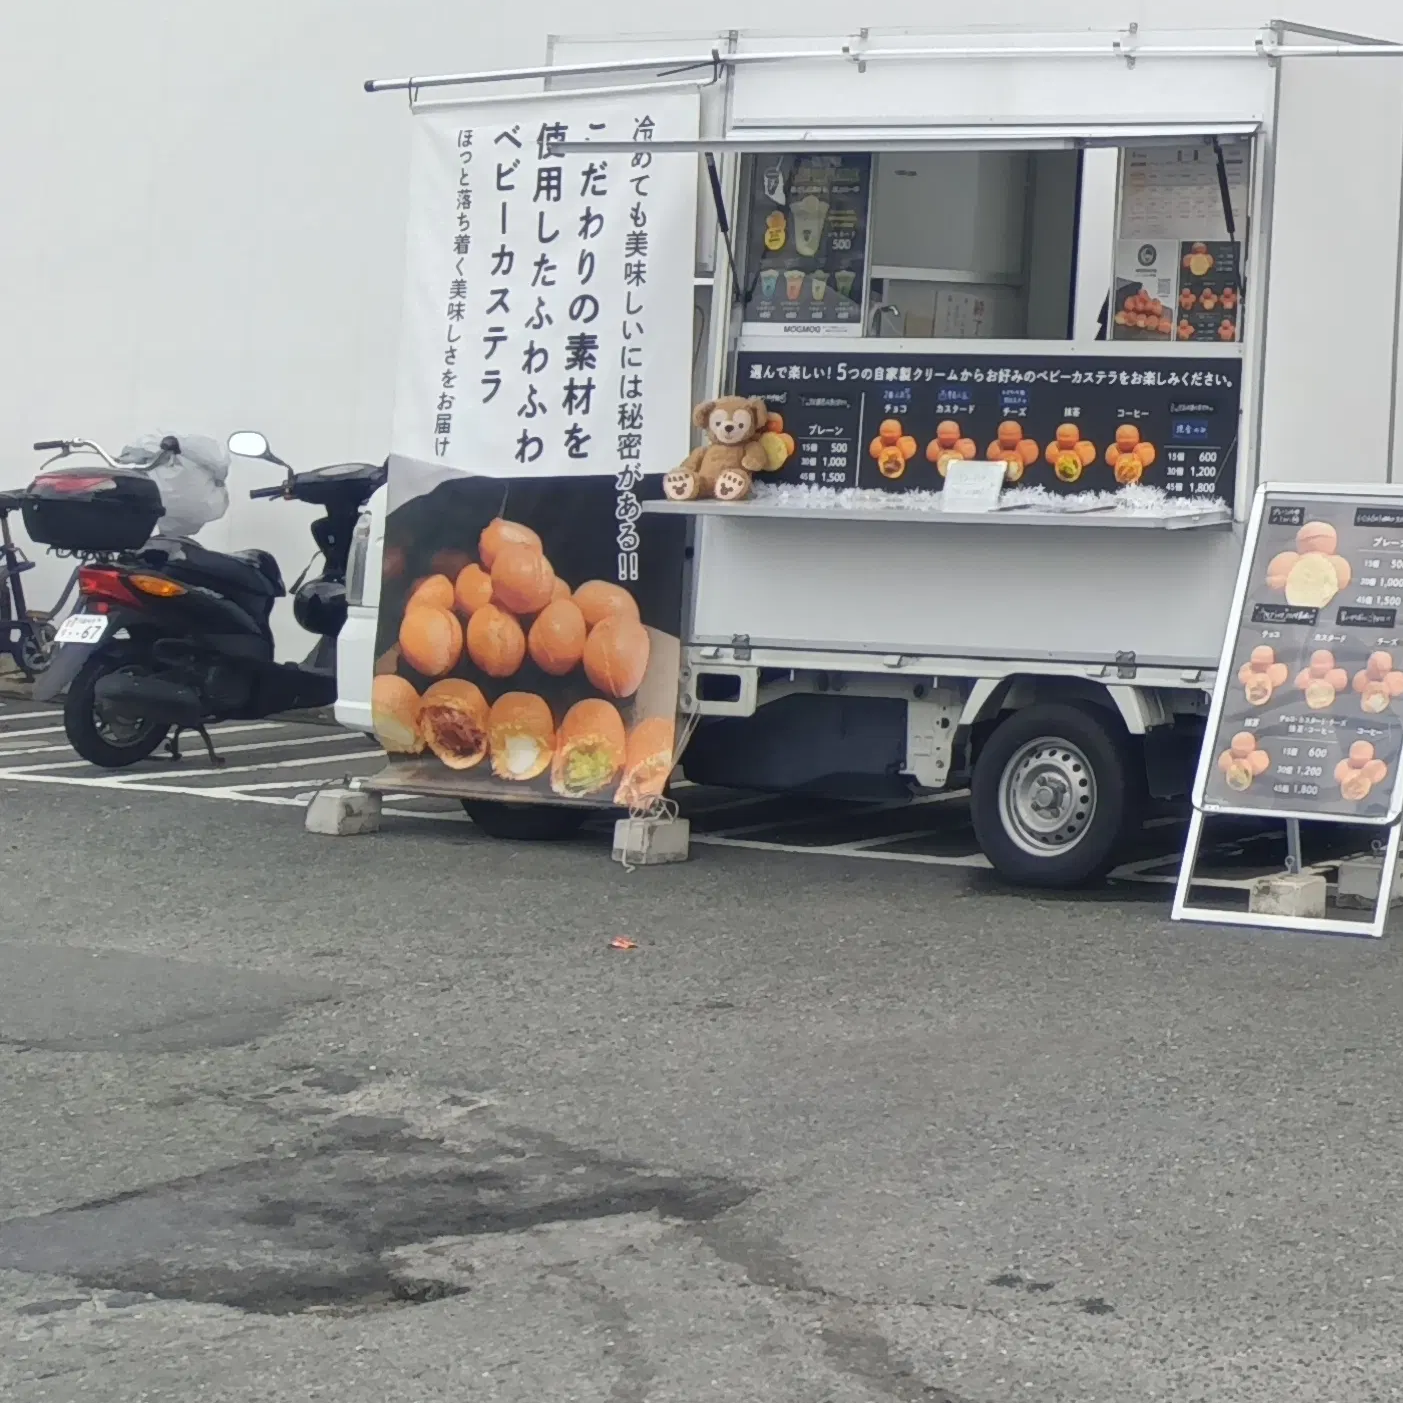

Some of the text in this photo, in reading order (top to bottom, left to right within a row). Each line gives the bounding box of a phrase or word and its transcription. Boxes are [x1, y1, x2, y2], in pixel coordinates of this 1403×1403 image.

[480, 123, 524, 405] ベビーカステラ
[433, 129, 474, 458] ほっと落ち着く美味しさをお届け
[515, 121, 569, 465] 使用したふわふわ
[1117, 408, 1149, 418] コーヒー
[830, 442, 848, 452] 500
[823, 457, 847, 467] 1,000
[1199, 452, 1217, 462] 600
[821, 472, 846, 483] 1,500
[1190, 466, 1216, 478] 1,200
[1189, 482, 1215, 493] 1,800
[1376, 595, 1402, 607] 1,500
[1308, 747, 1328, 758] 600
